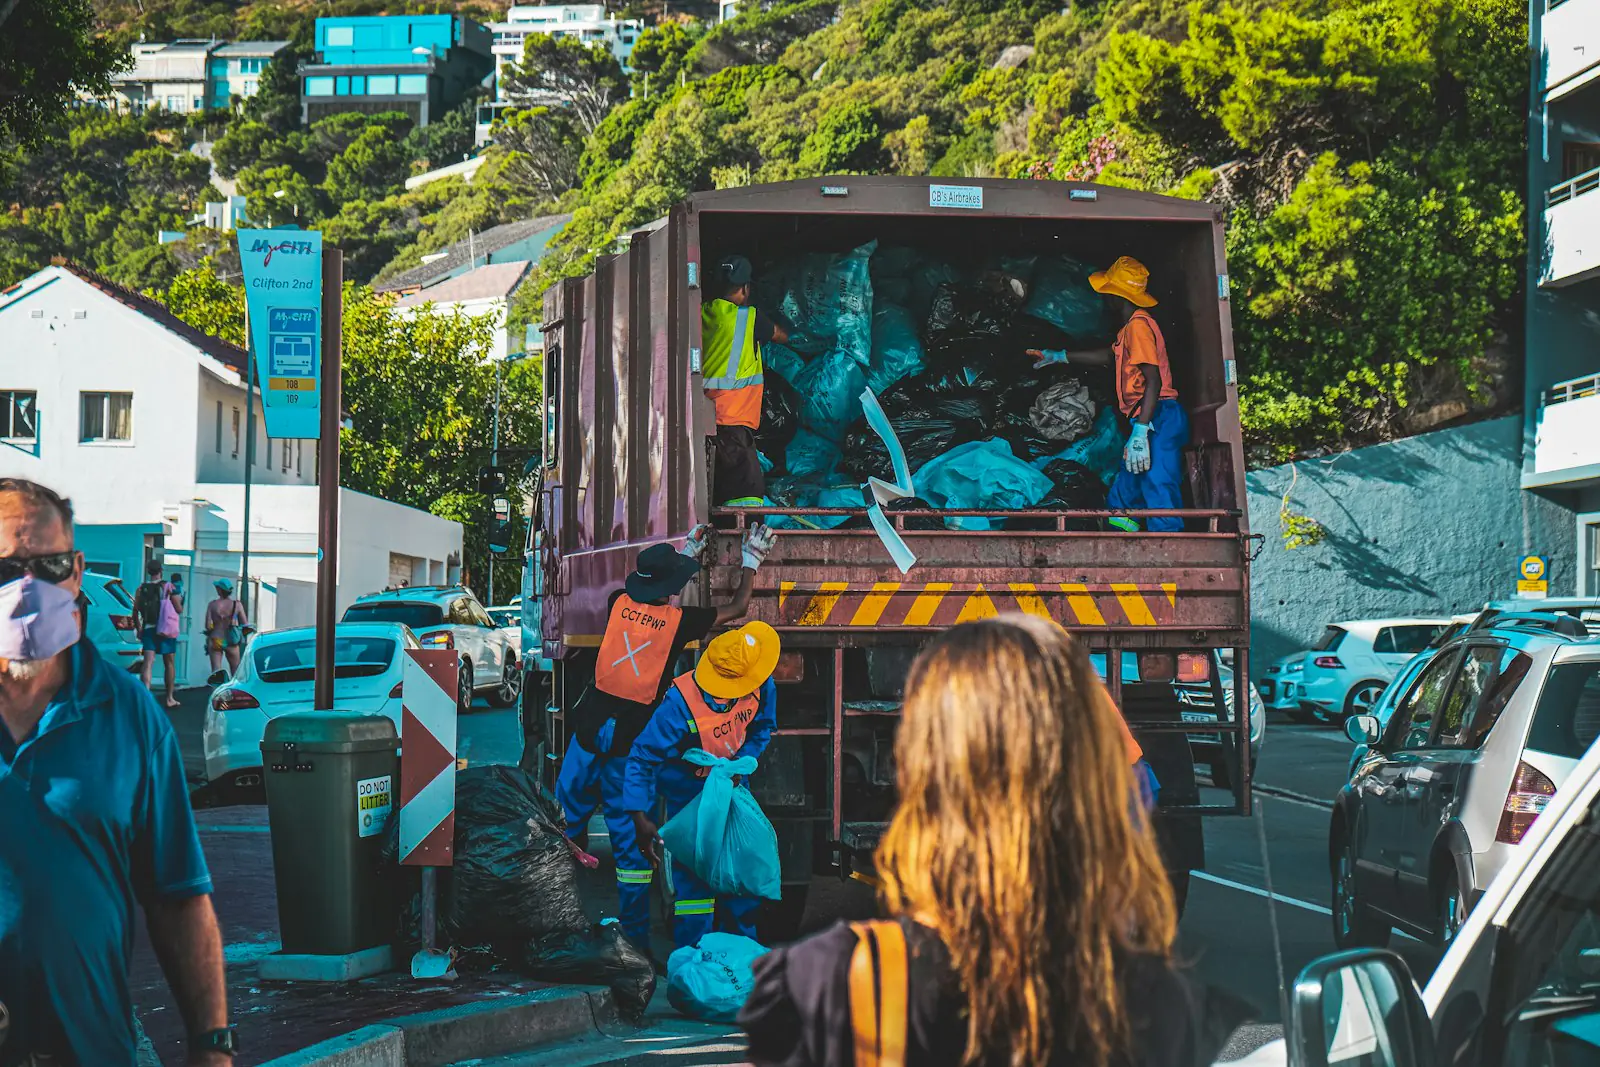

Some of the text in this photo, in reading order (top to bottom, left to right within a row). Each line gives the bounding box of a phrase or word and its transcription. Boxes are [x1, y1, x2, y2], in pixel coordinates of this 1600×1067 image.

[931, 190, 980, 204] CB's Airbrakes
[252, 277, 314, 291] Clifton 2nd
[286, 379, 299, 389] 108
[286, 394, 299, 405] 109
[621, 607, 666, 631] CCT EPWP
[713, 721, 732, 739] CCT
[360, 781, 389, 795] DO NOT
[361, 793, 390, 810] LITTER
